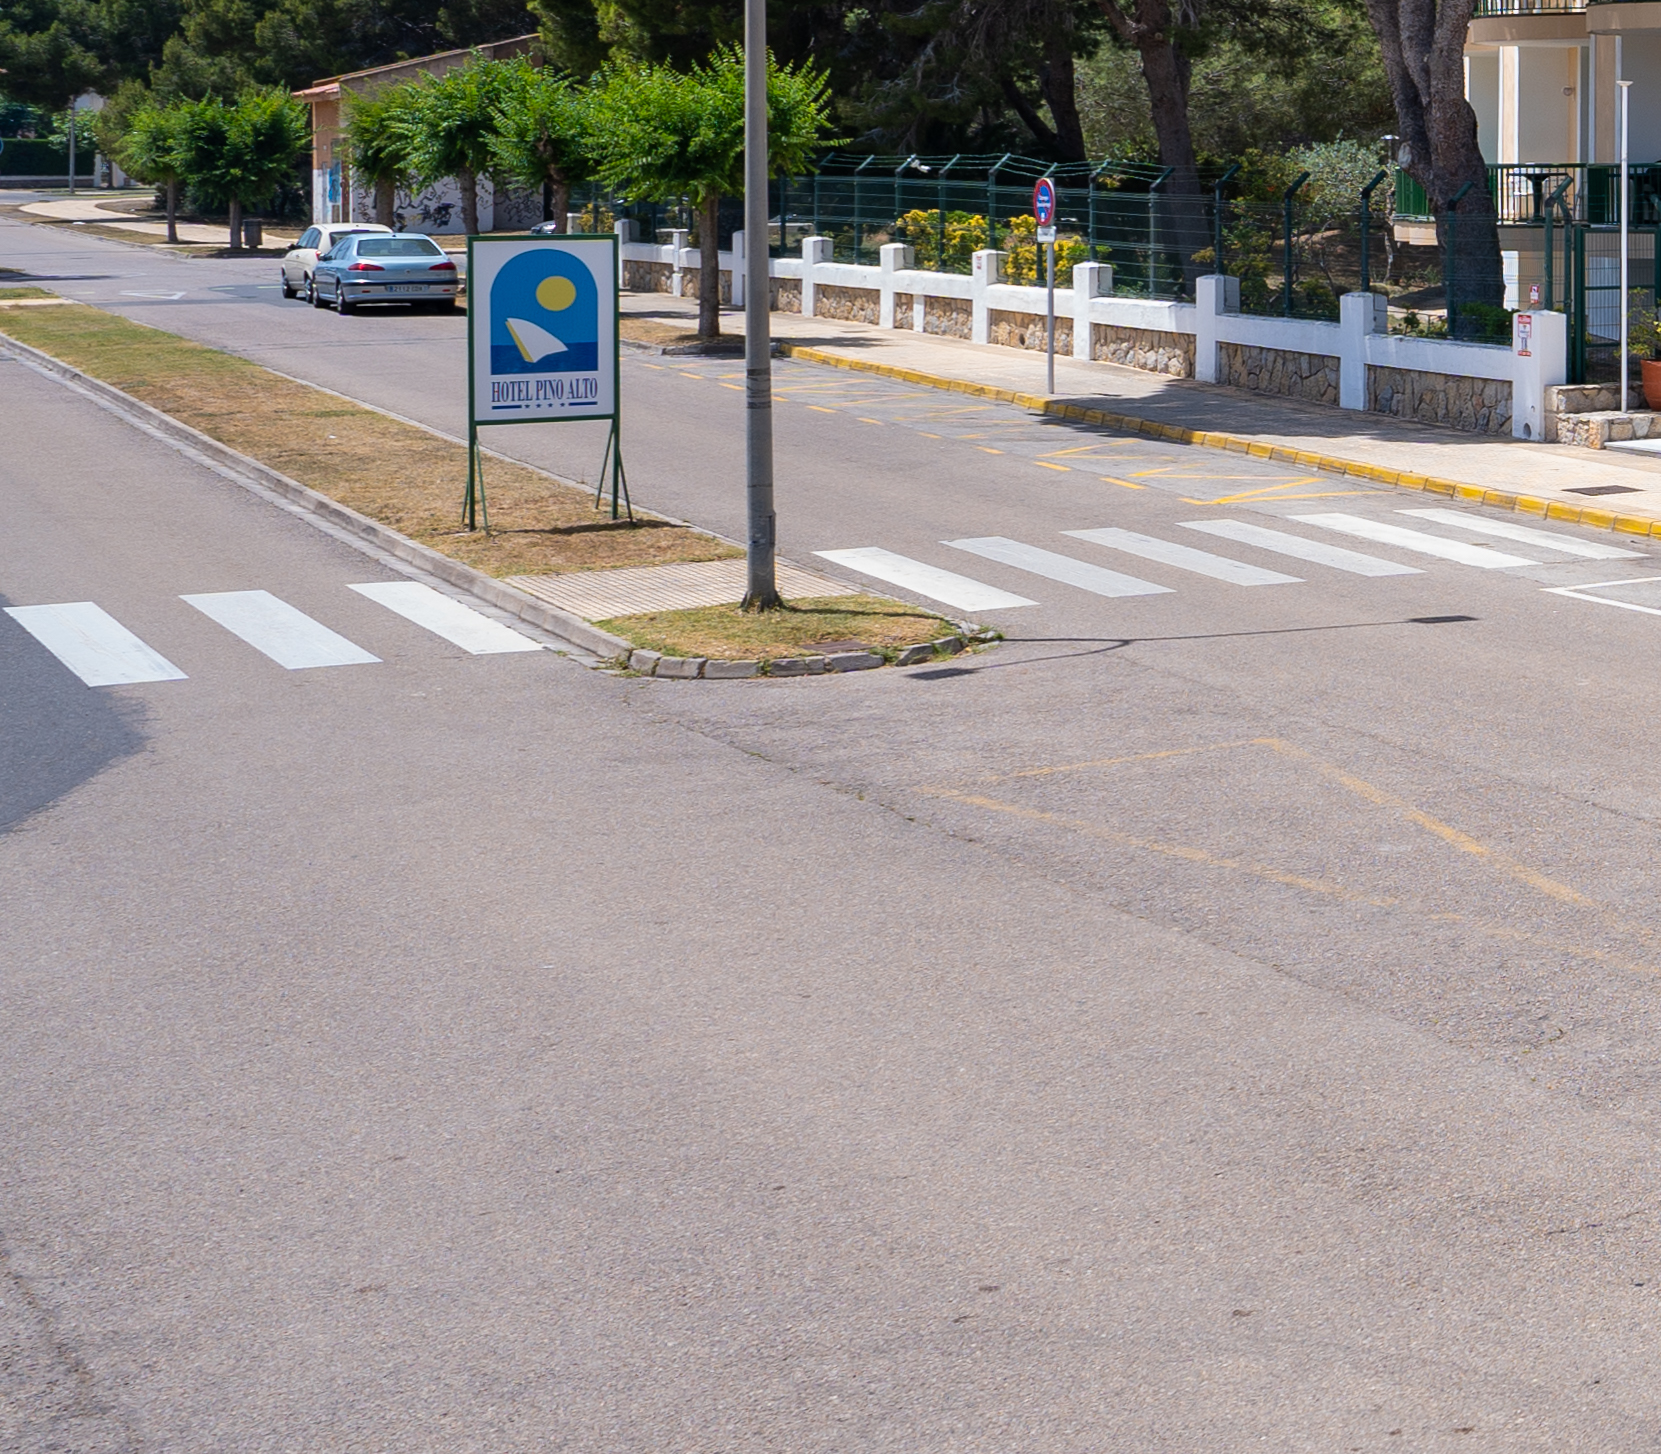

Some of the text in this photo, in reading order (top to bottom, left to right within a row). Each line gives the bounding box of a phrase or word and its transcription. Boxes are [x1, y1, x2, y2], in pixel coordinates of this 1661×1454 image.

[491, 378, 598, 403] HOTEL PINO ALTO
